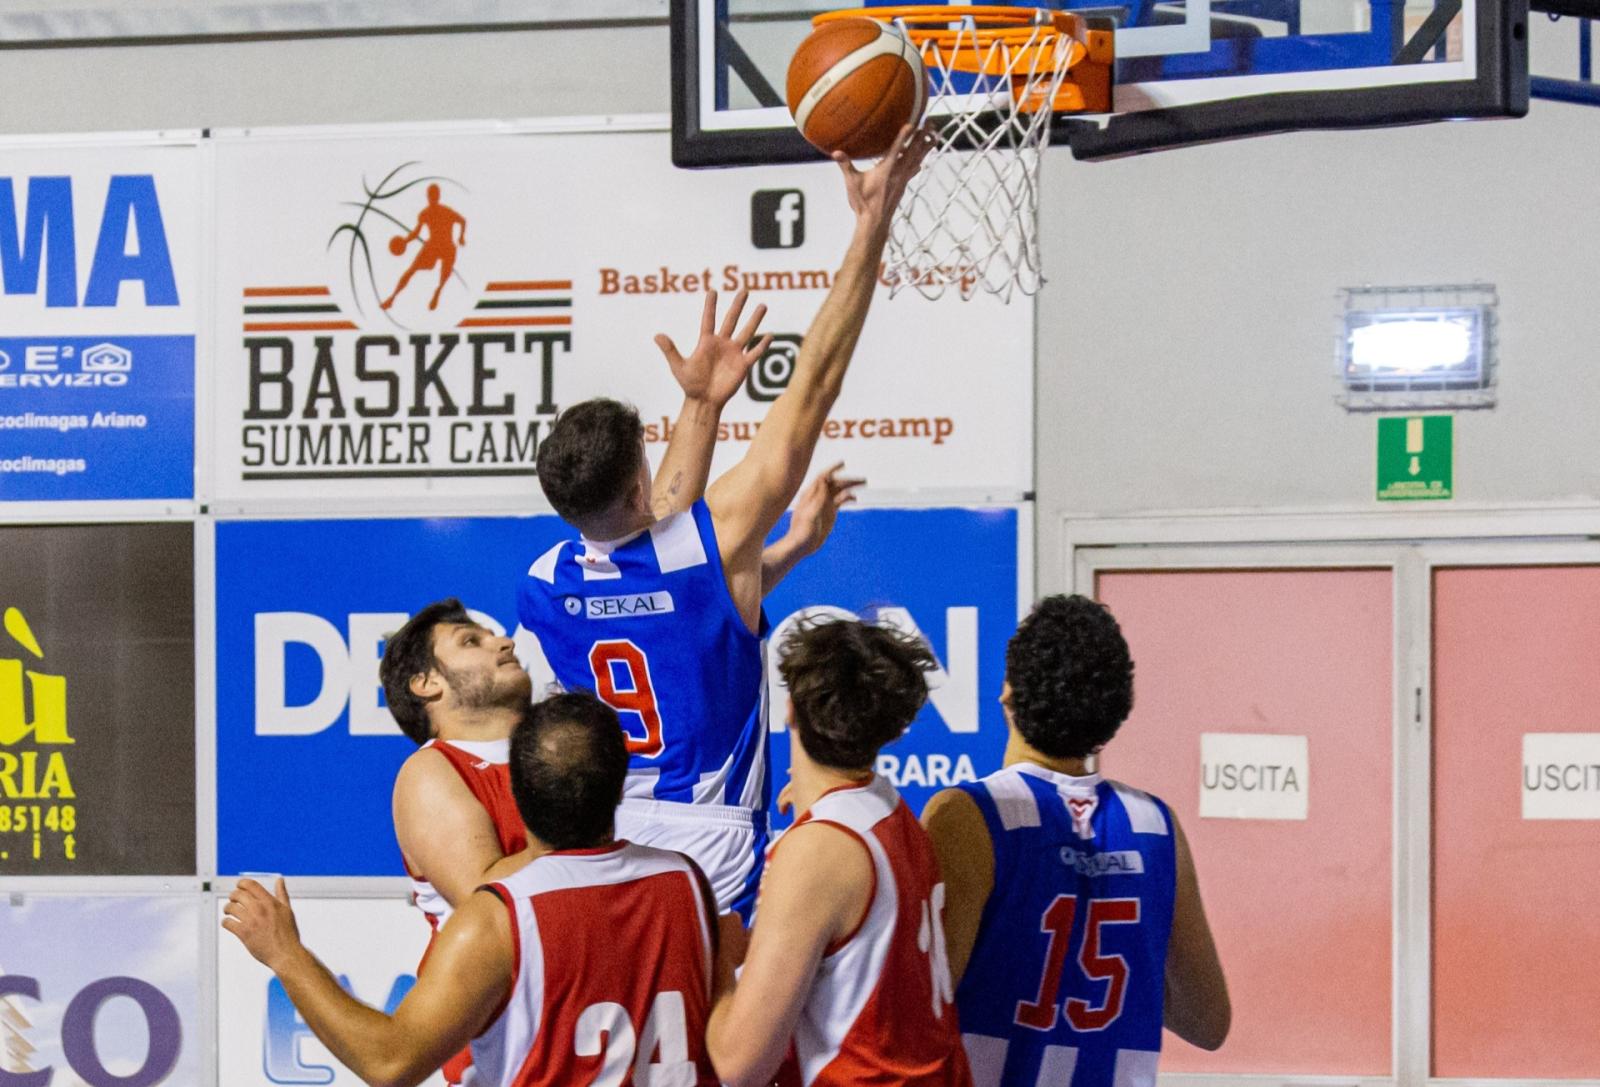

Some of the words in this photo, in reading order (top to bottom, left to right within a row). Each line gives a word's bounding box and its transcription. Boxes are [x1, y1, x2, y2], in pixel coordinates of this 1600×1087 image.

[599, 268, 713, 295] Basket
[722, 265, 836, 292] Summ
[243, 331, 572, 419] BASKET
[91, 411, 147, 428] Ariano
[242, 422, 429, 466] SUMMER
[450, 420, 553, 463] CAM
[590, 596, 666, 616] SEKAL
[588, 639, 665, 759] 9
[0, 751, 76, 799] RIA
[876, 754, 978, 787] RARA
[1203, 764, 1300, 792] USCITA
[0, 805, 77, 832] 85148
[1013, 894, 1141, 1032] 15
[574, 990, 698, 1087] 24
